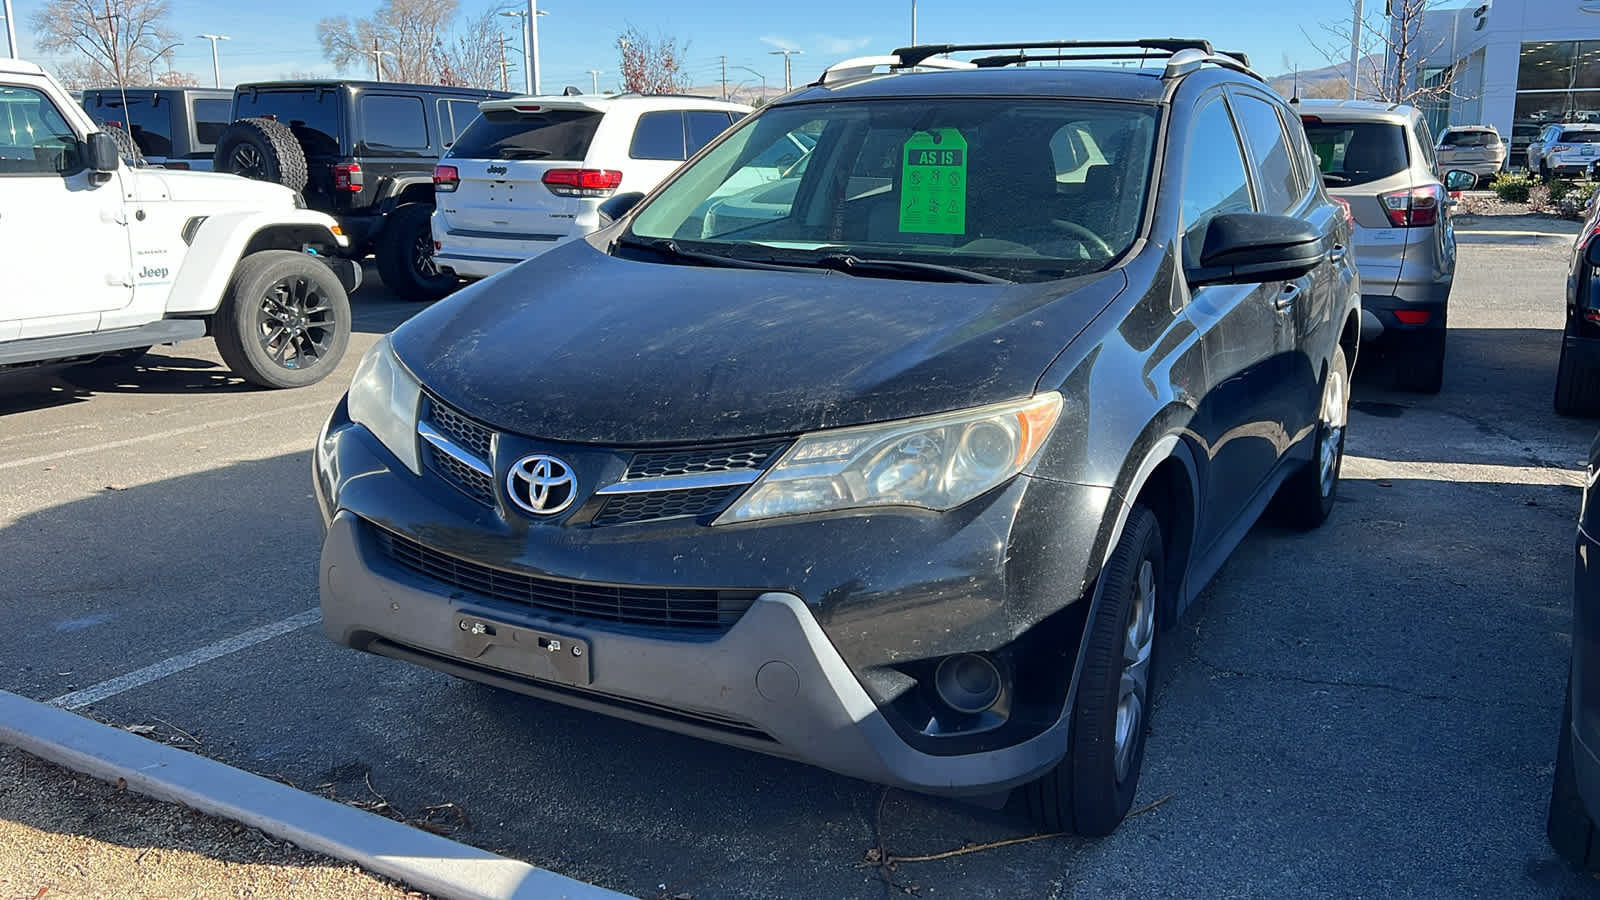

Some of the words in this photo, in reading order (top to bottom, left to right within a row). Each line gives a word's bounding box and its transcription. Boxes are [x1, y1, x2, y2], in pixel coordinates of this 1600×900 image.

[919, 151, 937, 165] AS
[941, 151, 954, 165] IS
[487, 164, 508, 176] Jeep
[139, 266, 169, 278] Jeep
